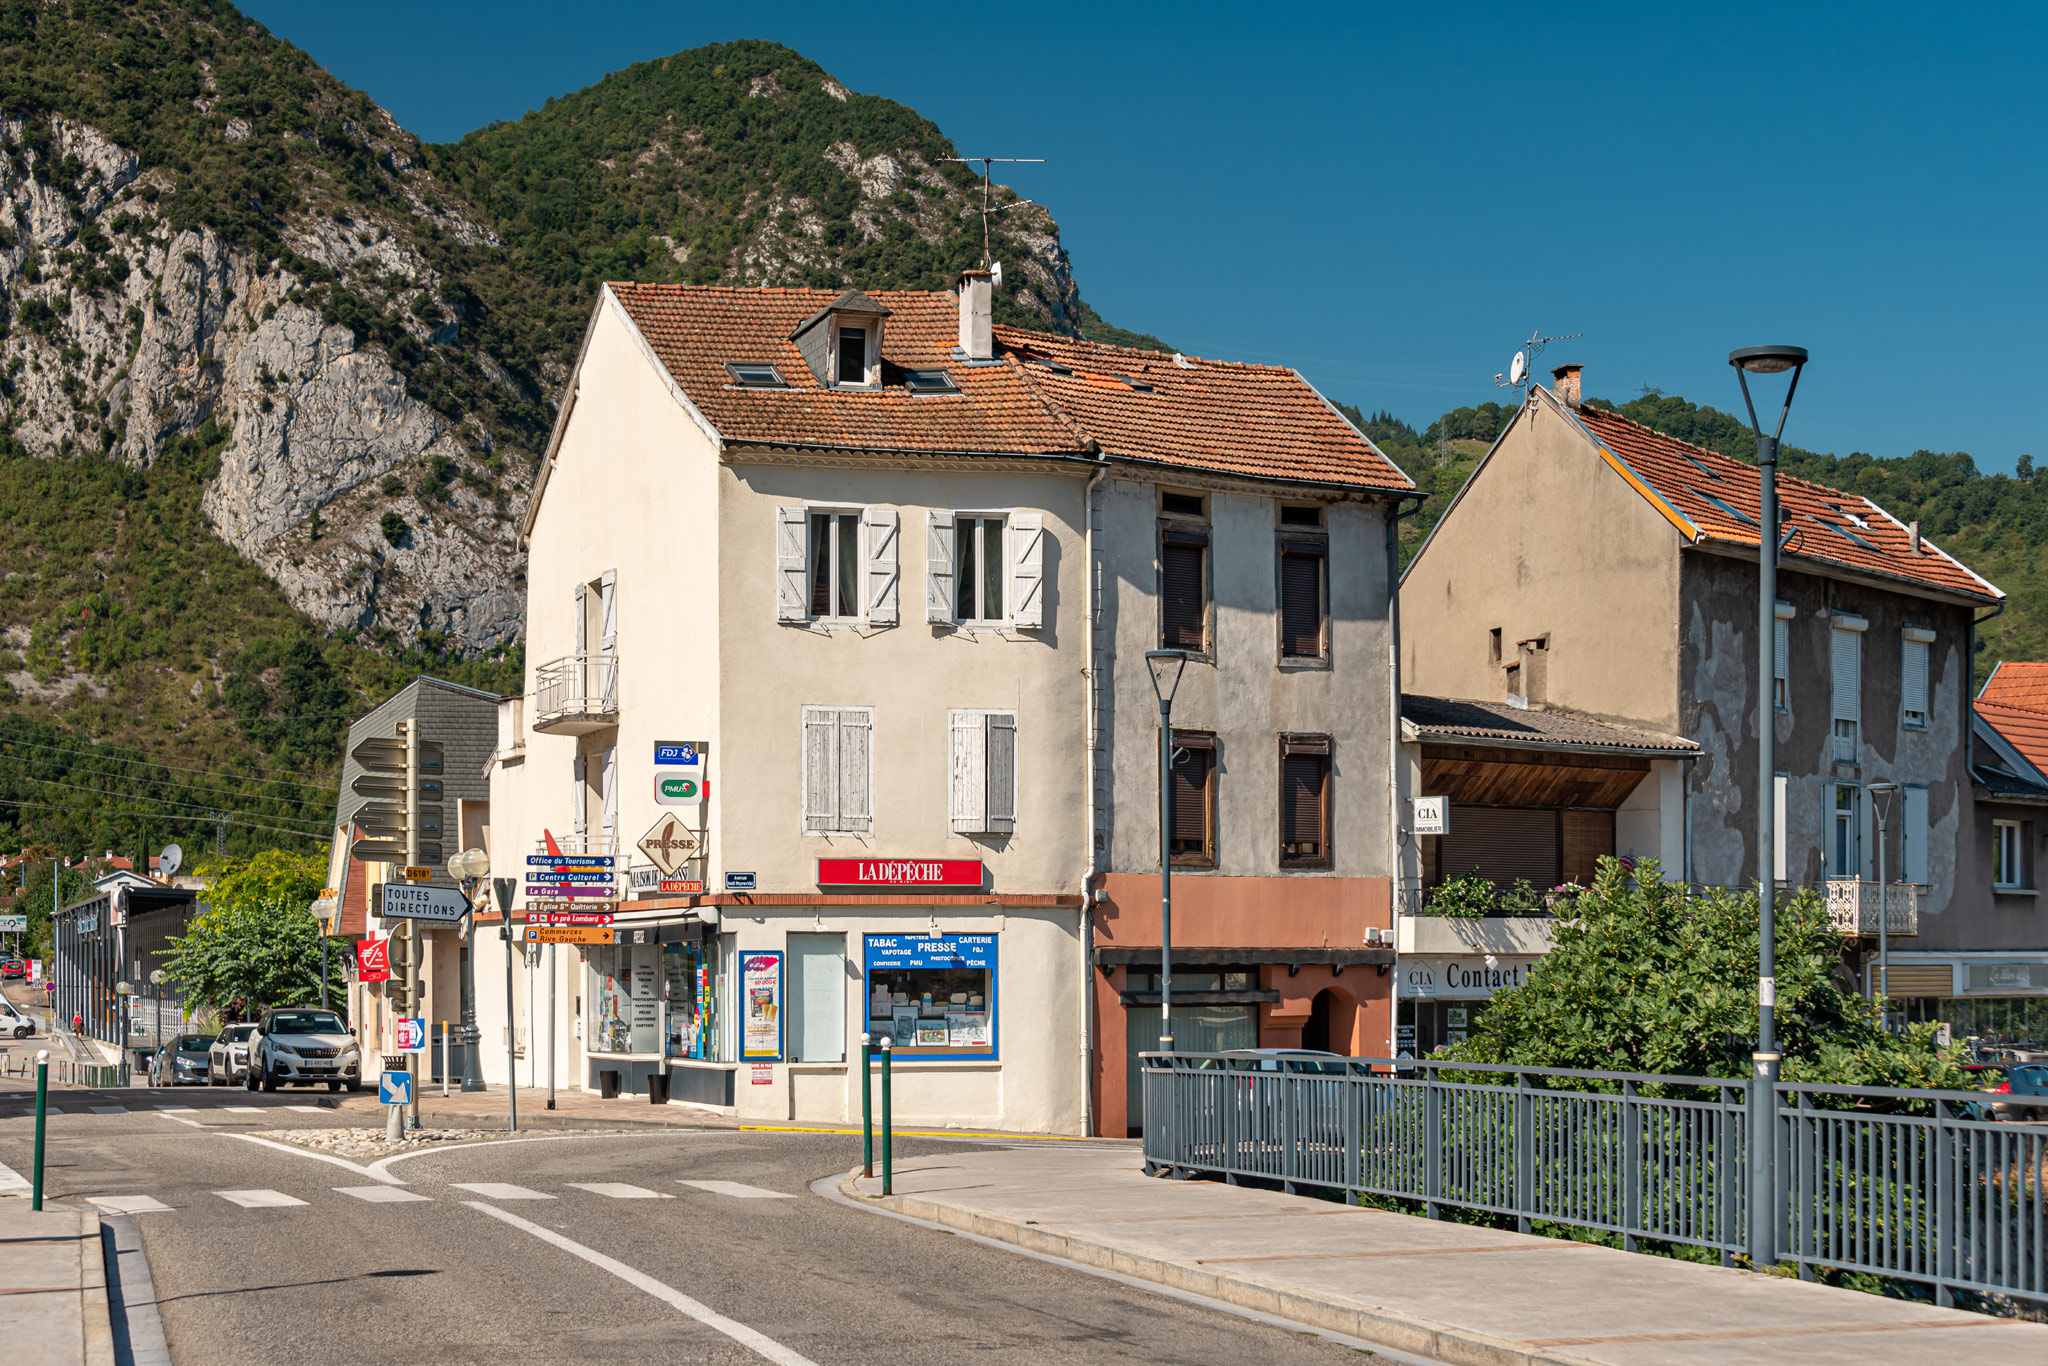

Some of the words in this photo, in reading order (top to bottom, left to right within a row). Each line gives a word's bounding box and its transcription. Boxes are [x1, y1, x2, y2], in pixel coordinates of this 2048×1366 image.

[660, 748, 679, 757] FDJ
[664, 785, 683, 793] PMU
[1418, 807, 1438, 820] CIA
[1415, 825, 1442, 833] IMMOBILIER
[645, 839, 695, 850] PRESSE
[530, 856, 553, 865] Office
[564, 857, 596, 866] Tourisme
[539, 873, 566, 881] Centre
[568, 873, 600, 881] Culturel
[387, 888, 430, 902] TOUTES
[529, 887, 539, 895] La
[541, 887, 559, 895] Gare
[387, 901, 455, 916] DIRECTIONS
[539, 901, 559, 912] Église
[551, 914, 559, 922] Le
[560, 914, 571, 923] pré
[868, 938, 898, 948] TABAC
[958, 936, 993, 944] CARTERIE
[917, 942, 957, 952] PRESSE
[966, 959, 986, 967] PÊCHE
[1409, 971, 1433, 985] CIA
[1446, 963, 1518, 988] Contact
